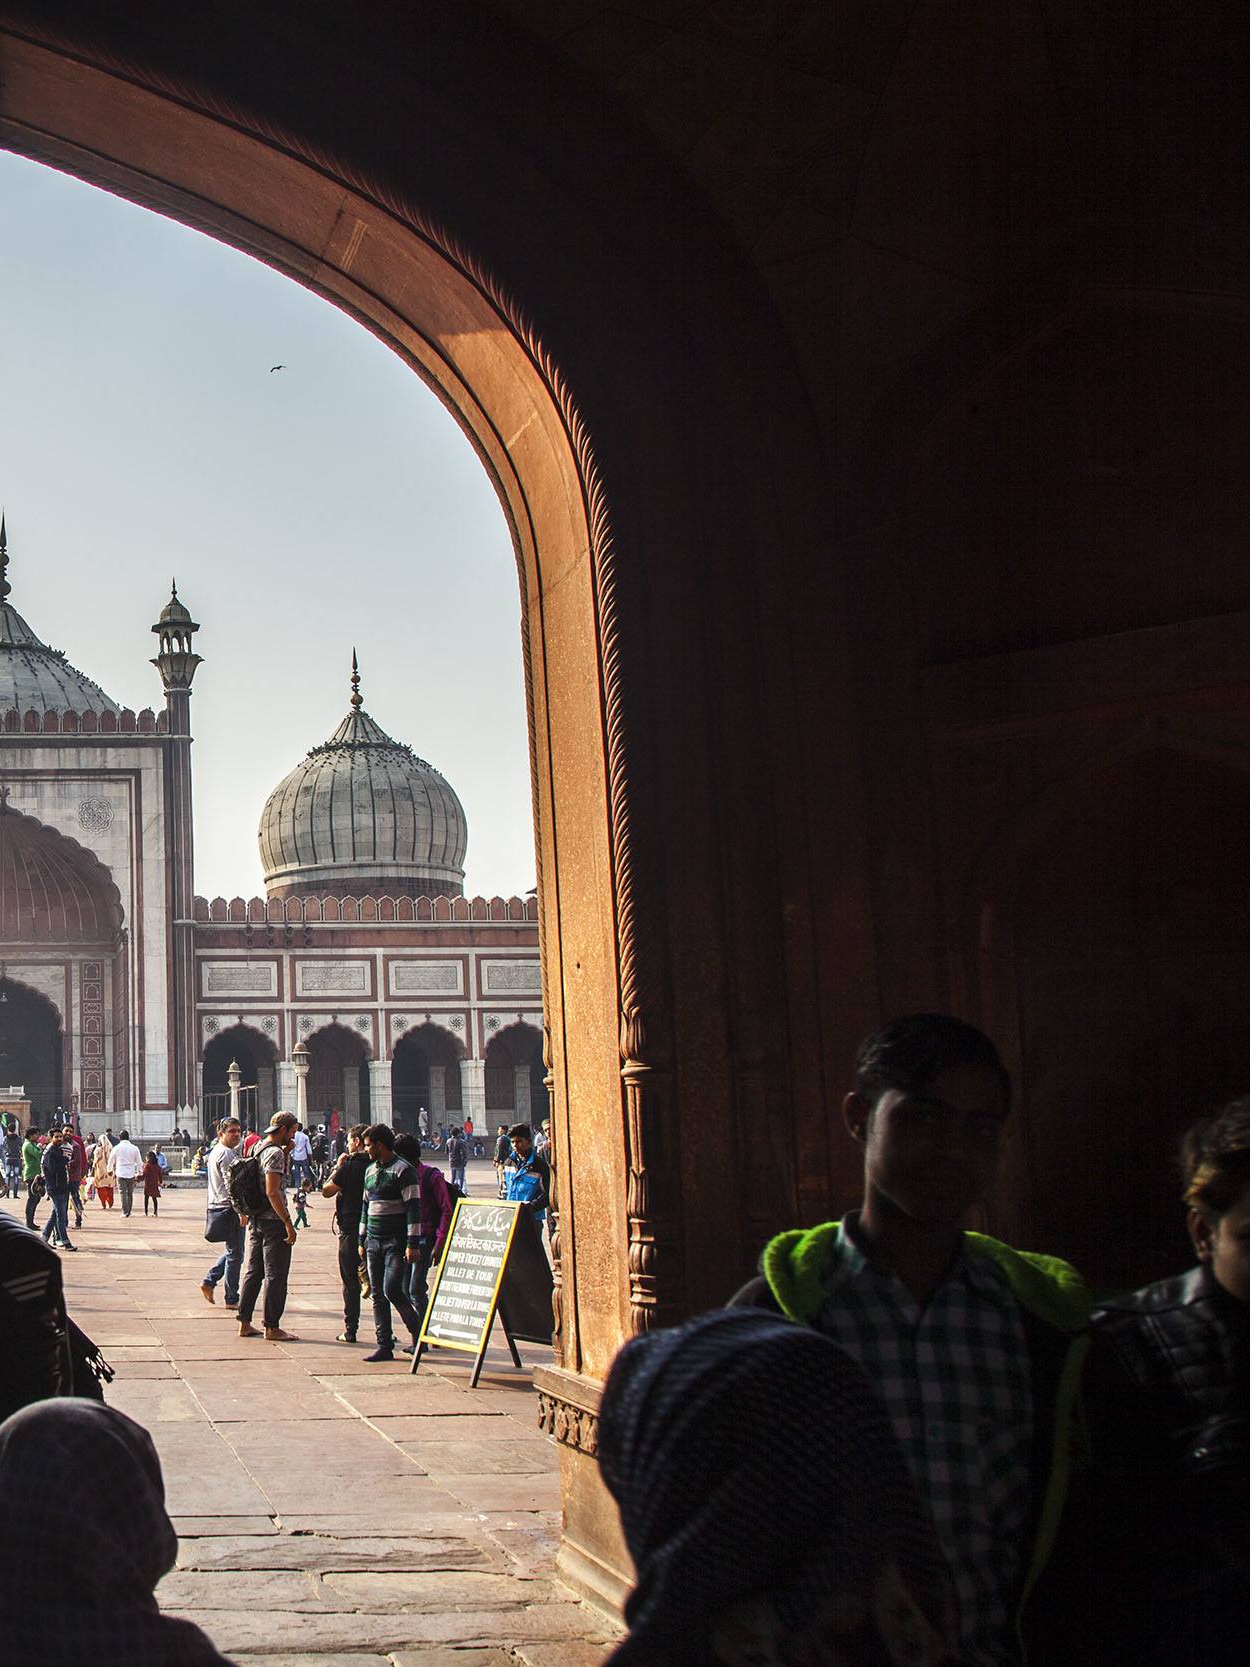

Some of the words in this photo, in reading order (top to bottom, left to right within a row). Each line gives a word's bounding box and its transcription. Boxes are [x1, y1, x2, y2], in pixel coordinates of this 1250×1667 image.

[446, 1267, 466, 1278] BILLET
[466, 1269, 475, 1279] DE
[476, 1271, 493, 1281] TOUR
